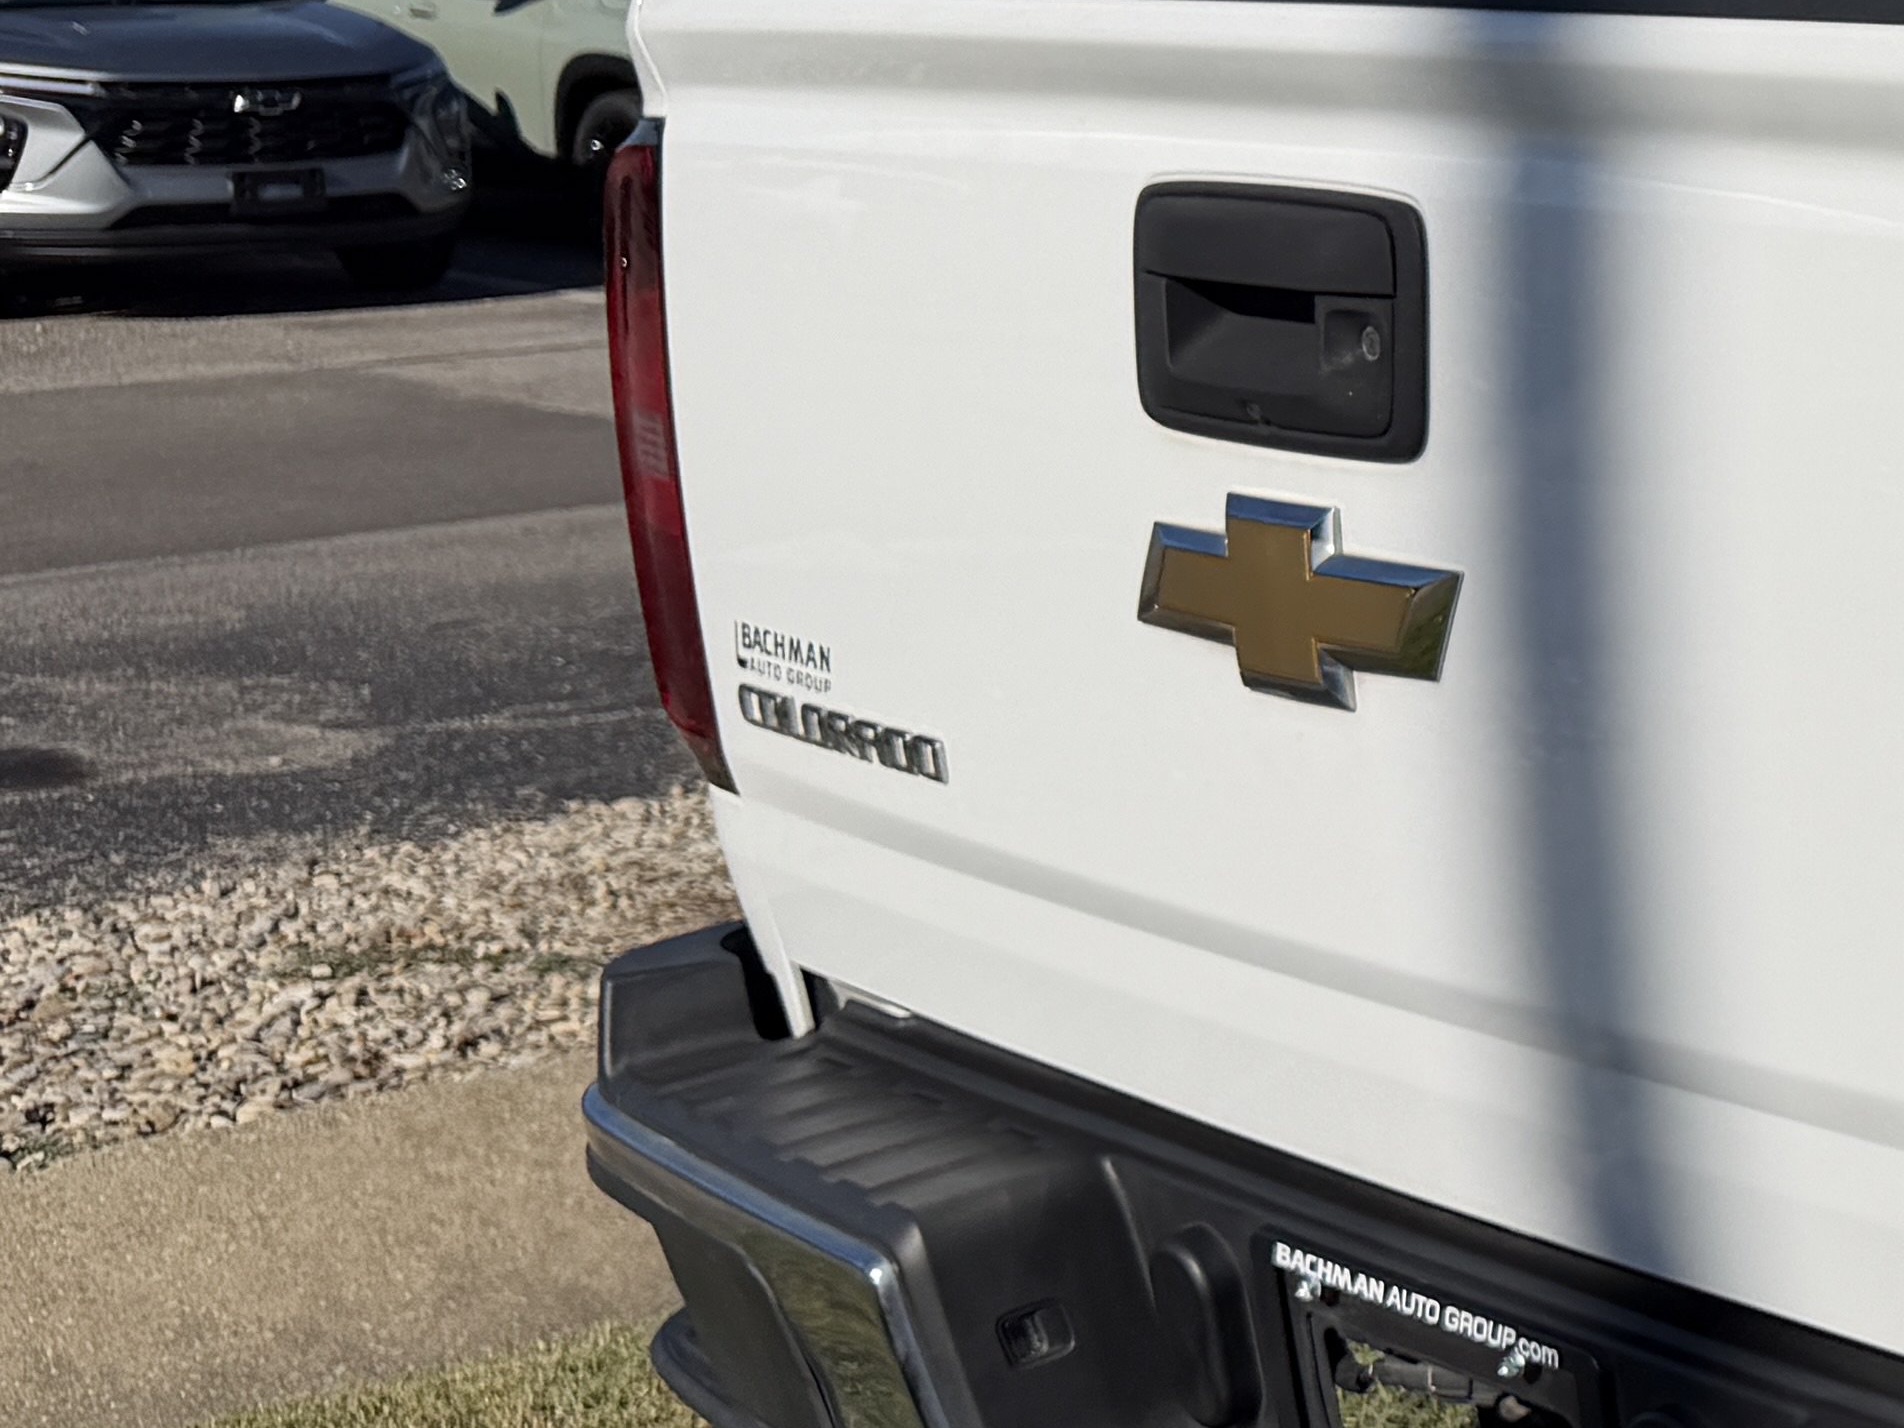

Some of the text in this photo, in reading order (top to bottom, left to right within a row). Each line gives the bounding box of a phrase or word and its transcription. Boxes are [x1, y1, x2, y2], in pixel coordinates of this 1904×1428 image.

[740, 621, 831, 673] BACHMAN
[749, 657, 832, 693] AUTO GROUP
[738, 682, 949, 786] COLORADO
[1272, 1241, 1385, 1304] BACHMAN
[1387, 1285, 1441, 1325] AUTO
